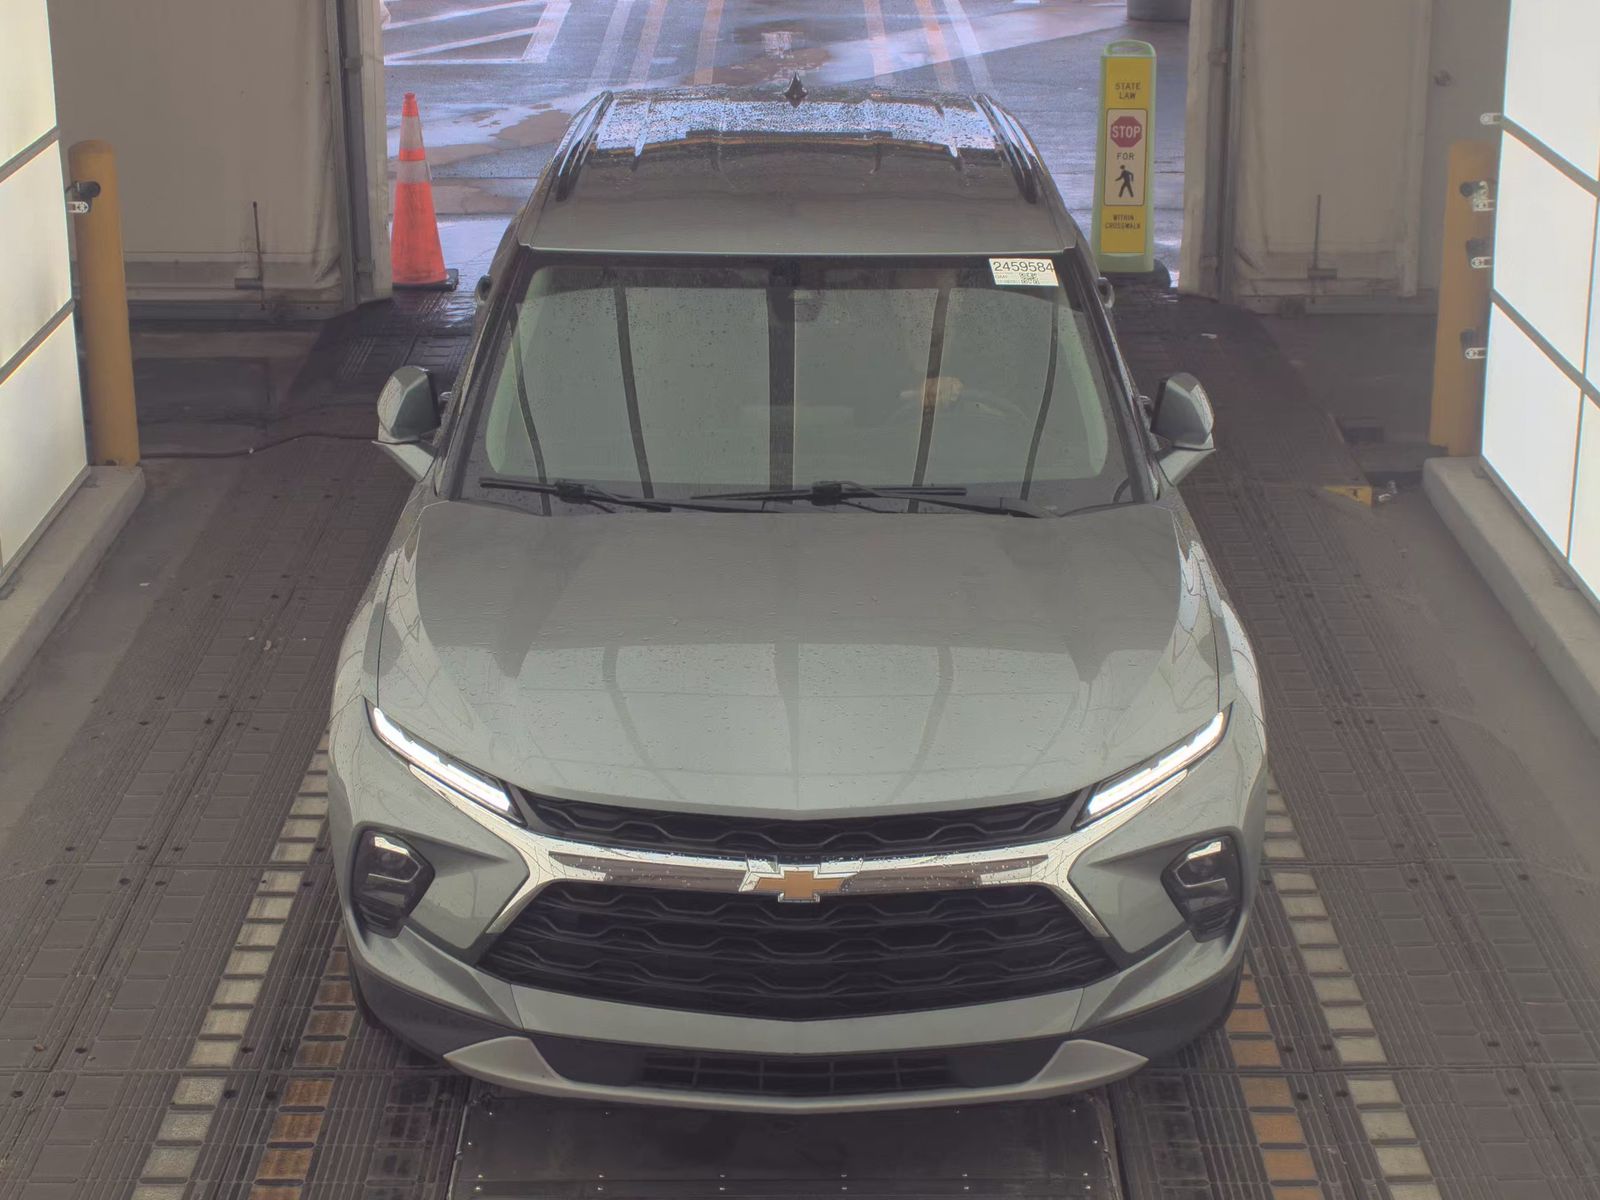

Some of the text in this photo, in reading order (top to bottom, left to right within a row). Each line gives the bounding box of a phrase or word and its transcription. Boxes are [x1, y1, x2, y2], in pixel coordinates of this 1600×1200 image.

[1115, 82, 1141, 90] STATE
[1119, 91, 1136, 100] LAW
[1111, 125, 1141, 139] STOP
[1116, 152, 1136, 161] FOR
[993, 261, 1055, 273] 2459584
